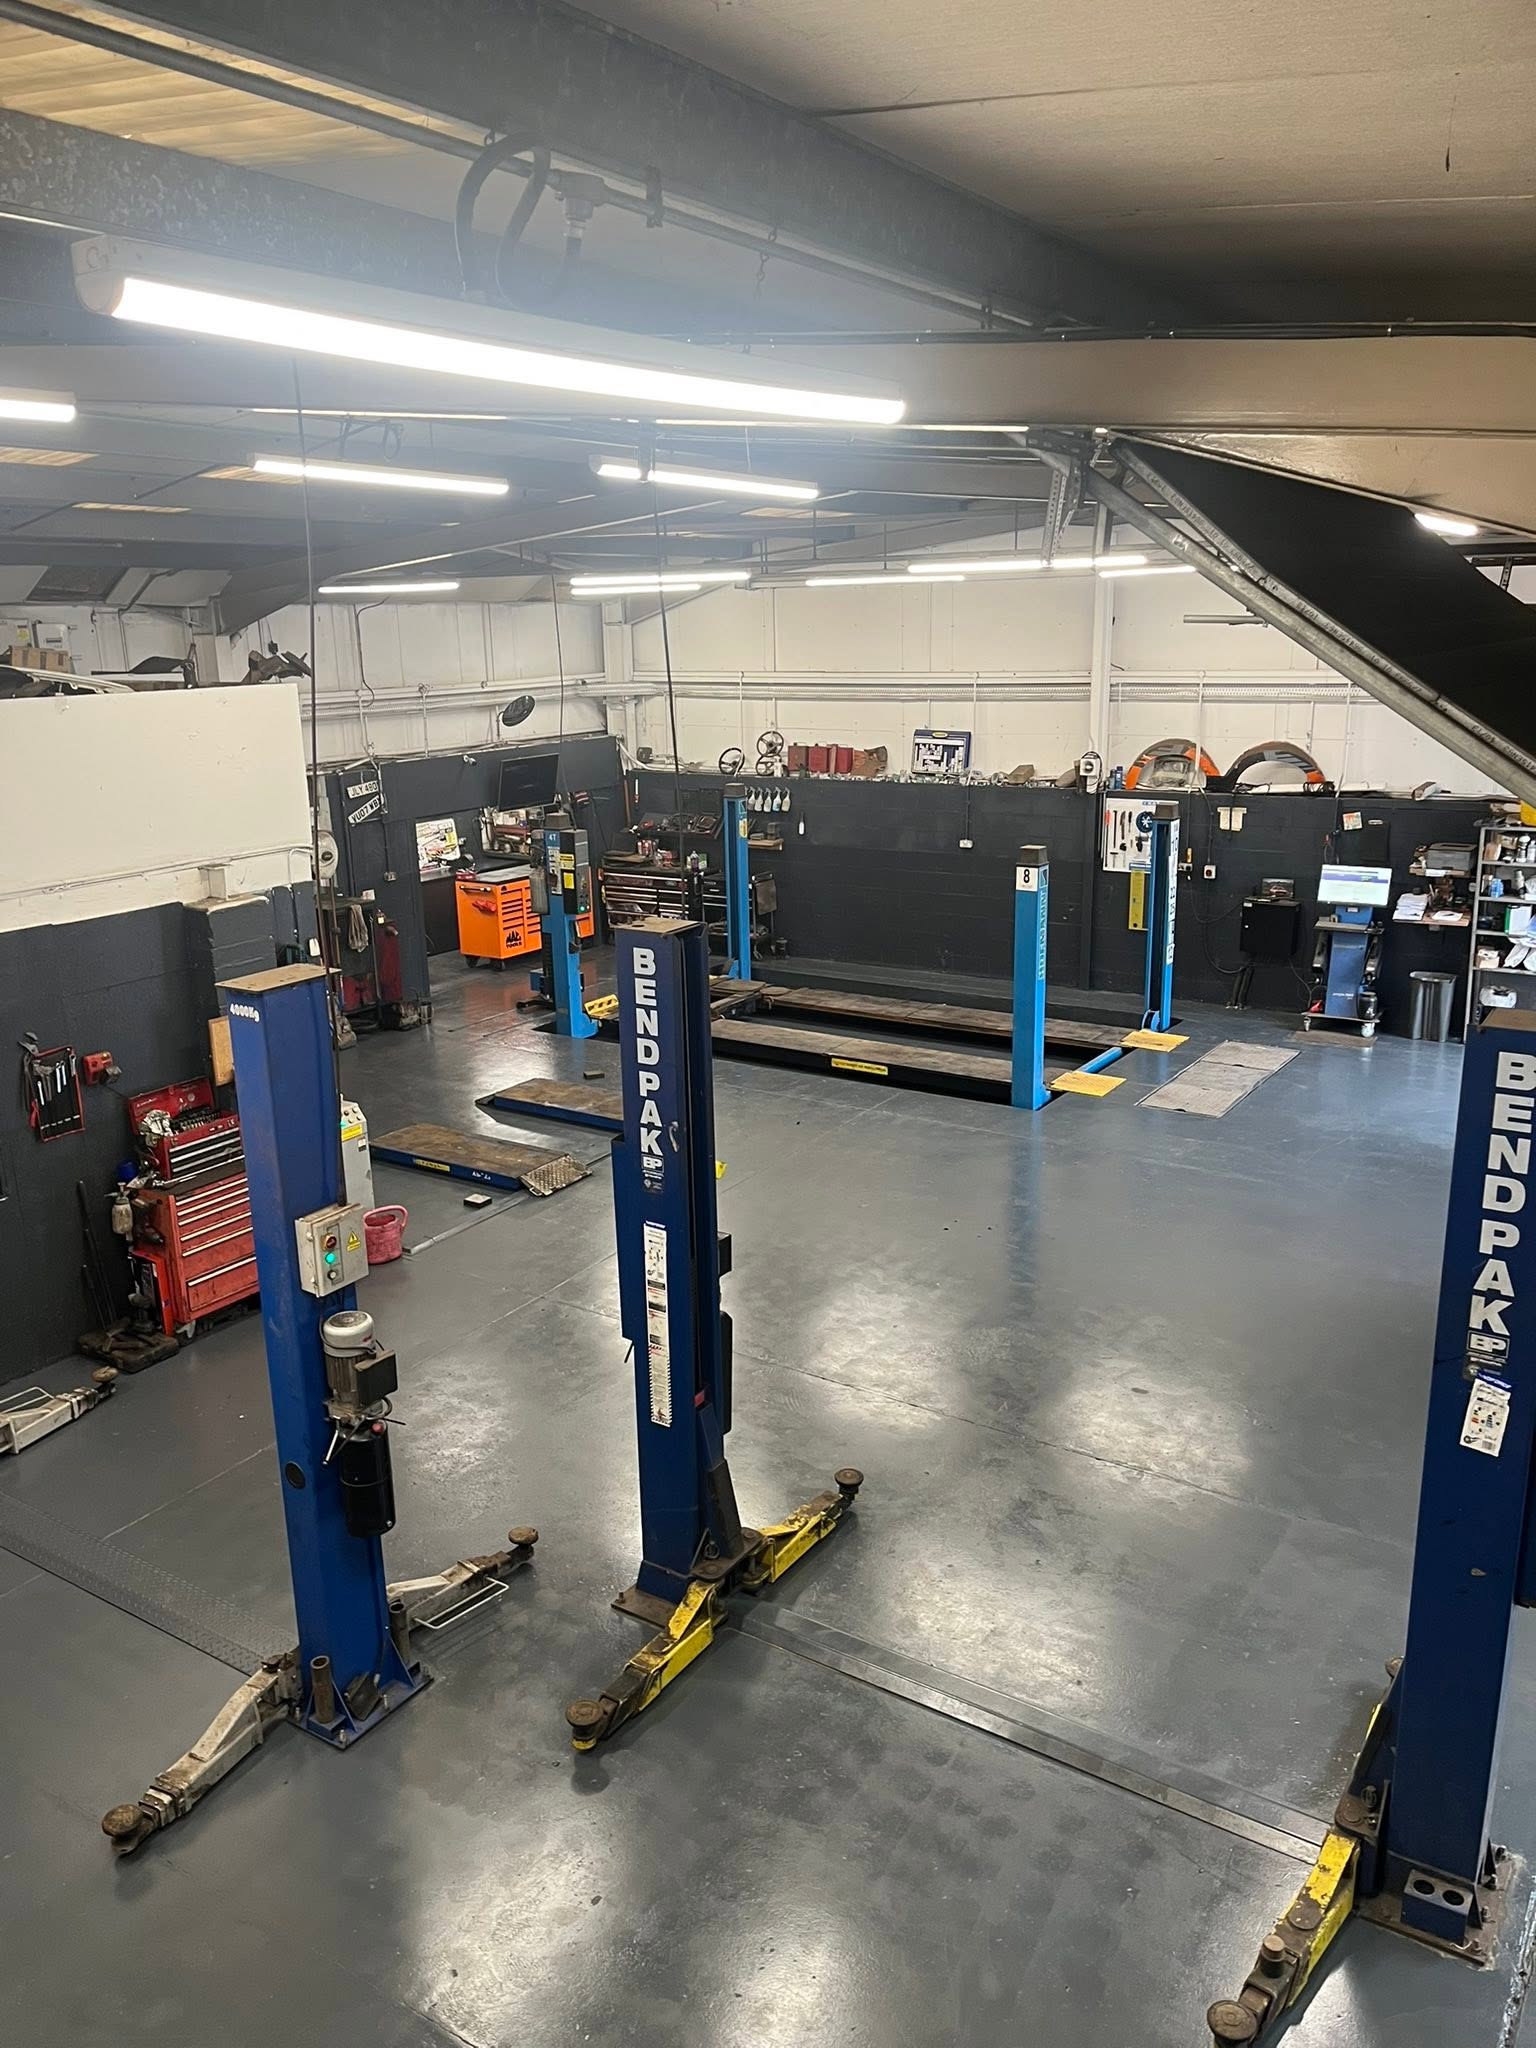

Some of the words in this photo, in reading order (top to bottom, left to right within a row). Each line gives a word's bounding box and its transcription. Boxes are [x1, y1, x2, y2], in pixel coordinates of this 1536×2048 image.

[1023, 868, 1030, 883] 8
[633, 947, 663, 1156] BENDPAK
[1469, 1051, 1536, 1336] BENDPAK
[1469, 1333, 1507, 1353] BP
